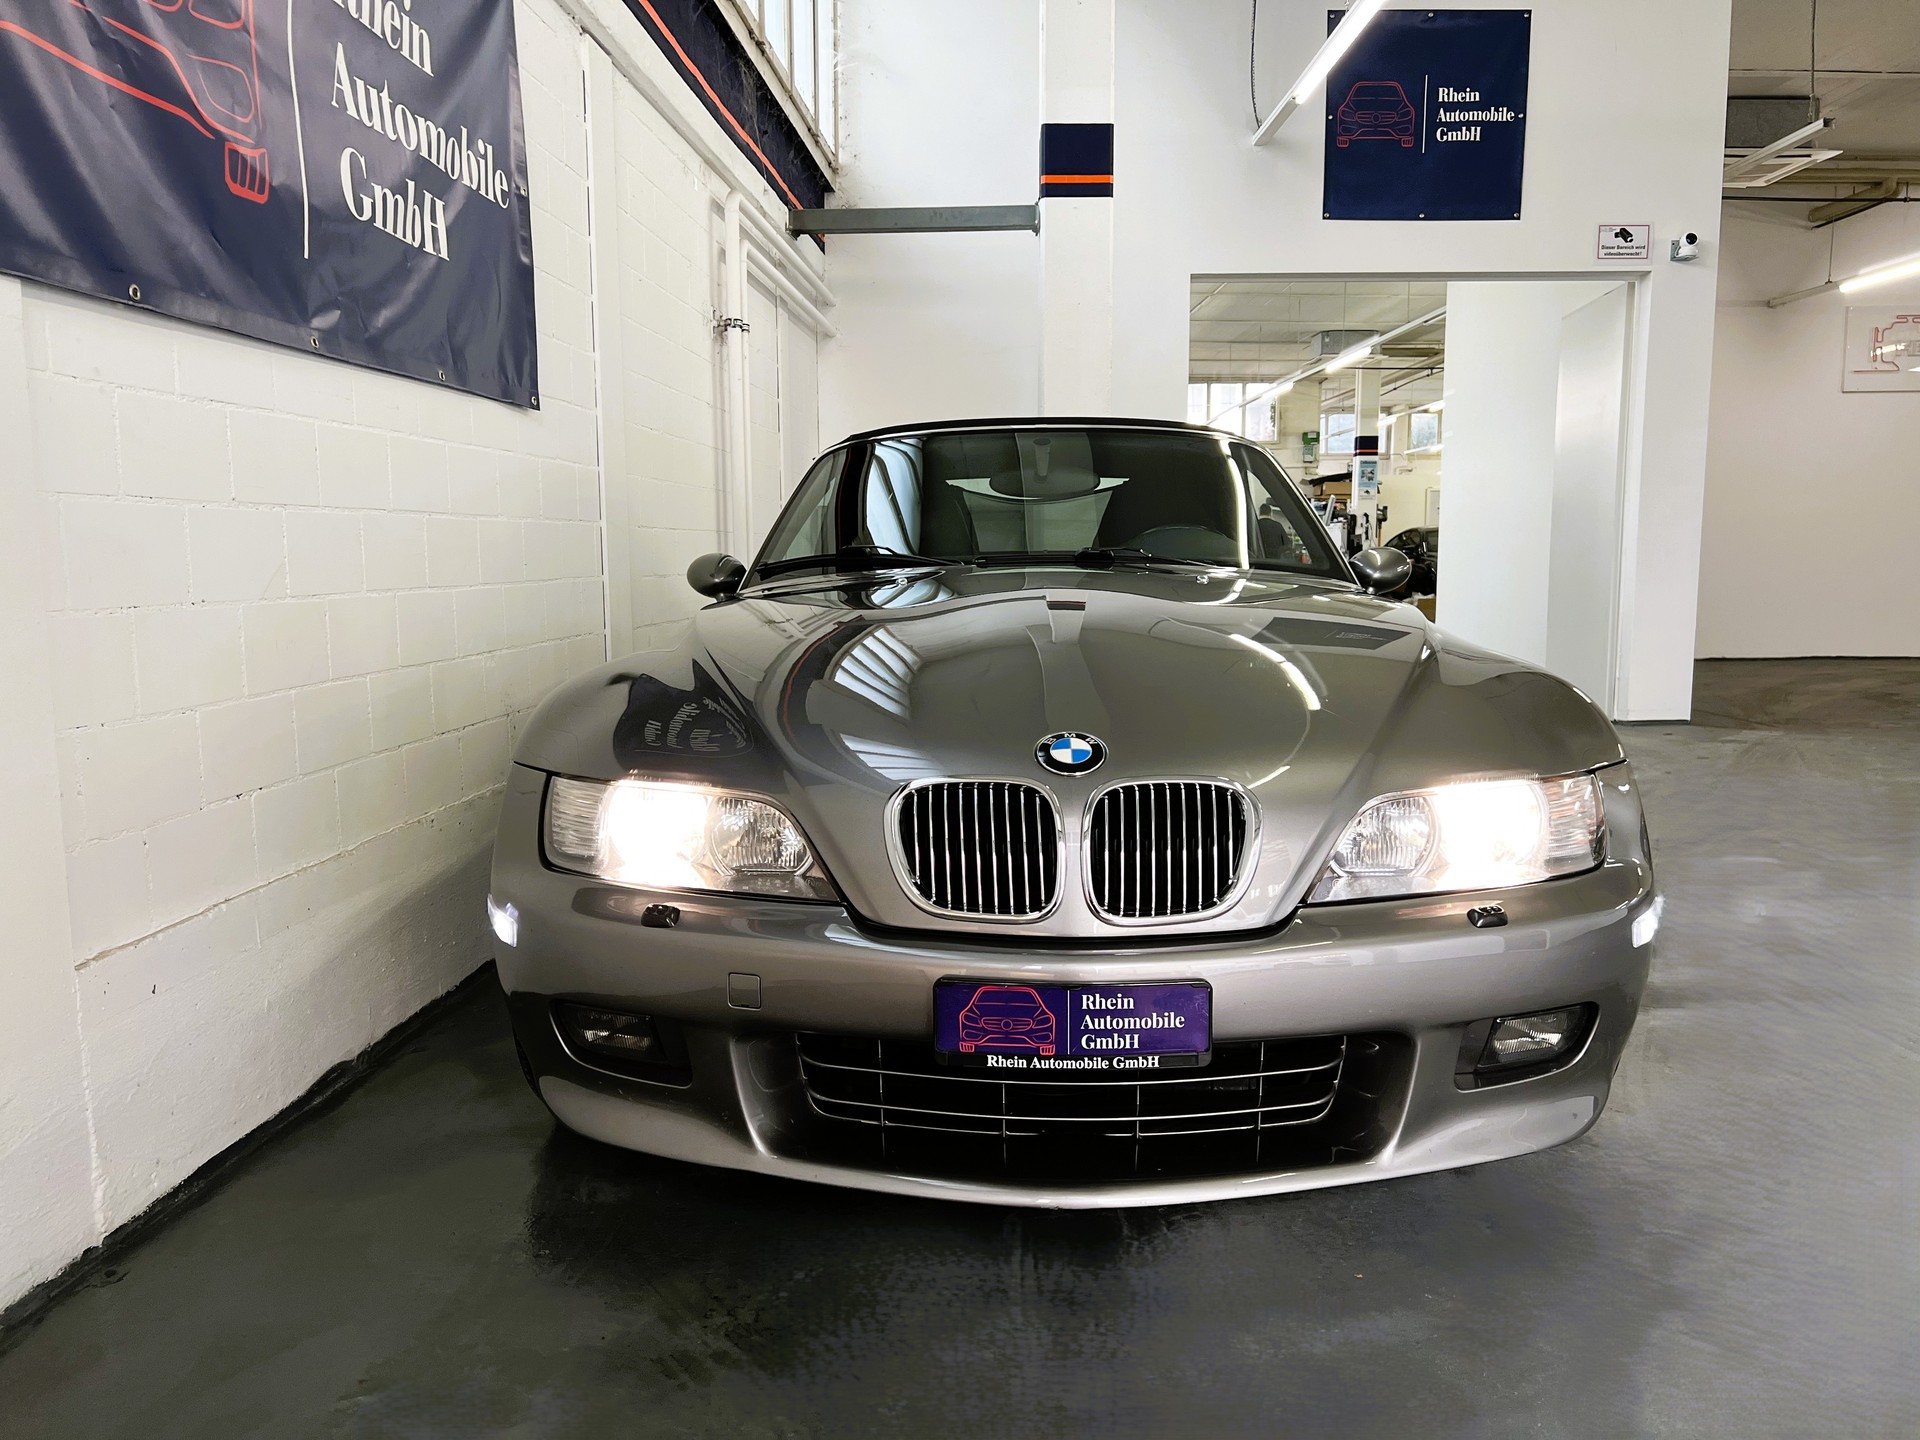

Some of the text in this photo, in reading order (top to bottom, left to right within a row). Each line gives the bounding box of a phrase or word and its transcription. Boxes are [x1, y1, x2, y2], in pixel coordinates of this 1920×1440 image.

[1438, 87, 1480, 102] Rhein
[1436, 106, 1515, 122] Automobile
[331, 42, 510, 209] Automobile
[1436, 126, 1482, 142] GmbH
[340, 147, 450, 262] GmbH
[1043, 733, 1098, 745] BMW
[1081, 993, 1135, 1010] Rhein
[1080, 1012, 1185, 1030] Automobile
[1081, 1033, 1140, 1050] GmbH
[986, 1055, 1160, 1069] Rhein Automobile GmbH
